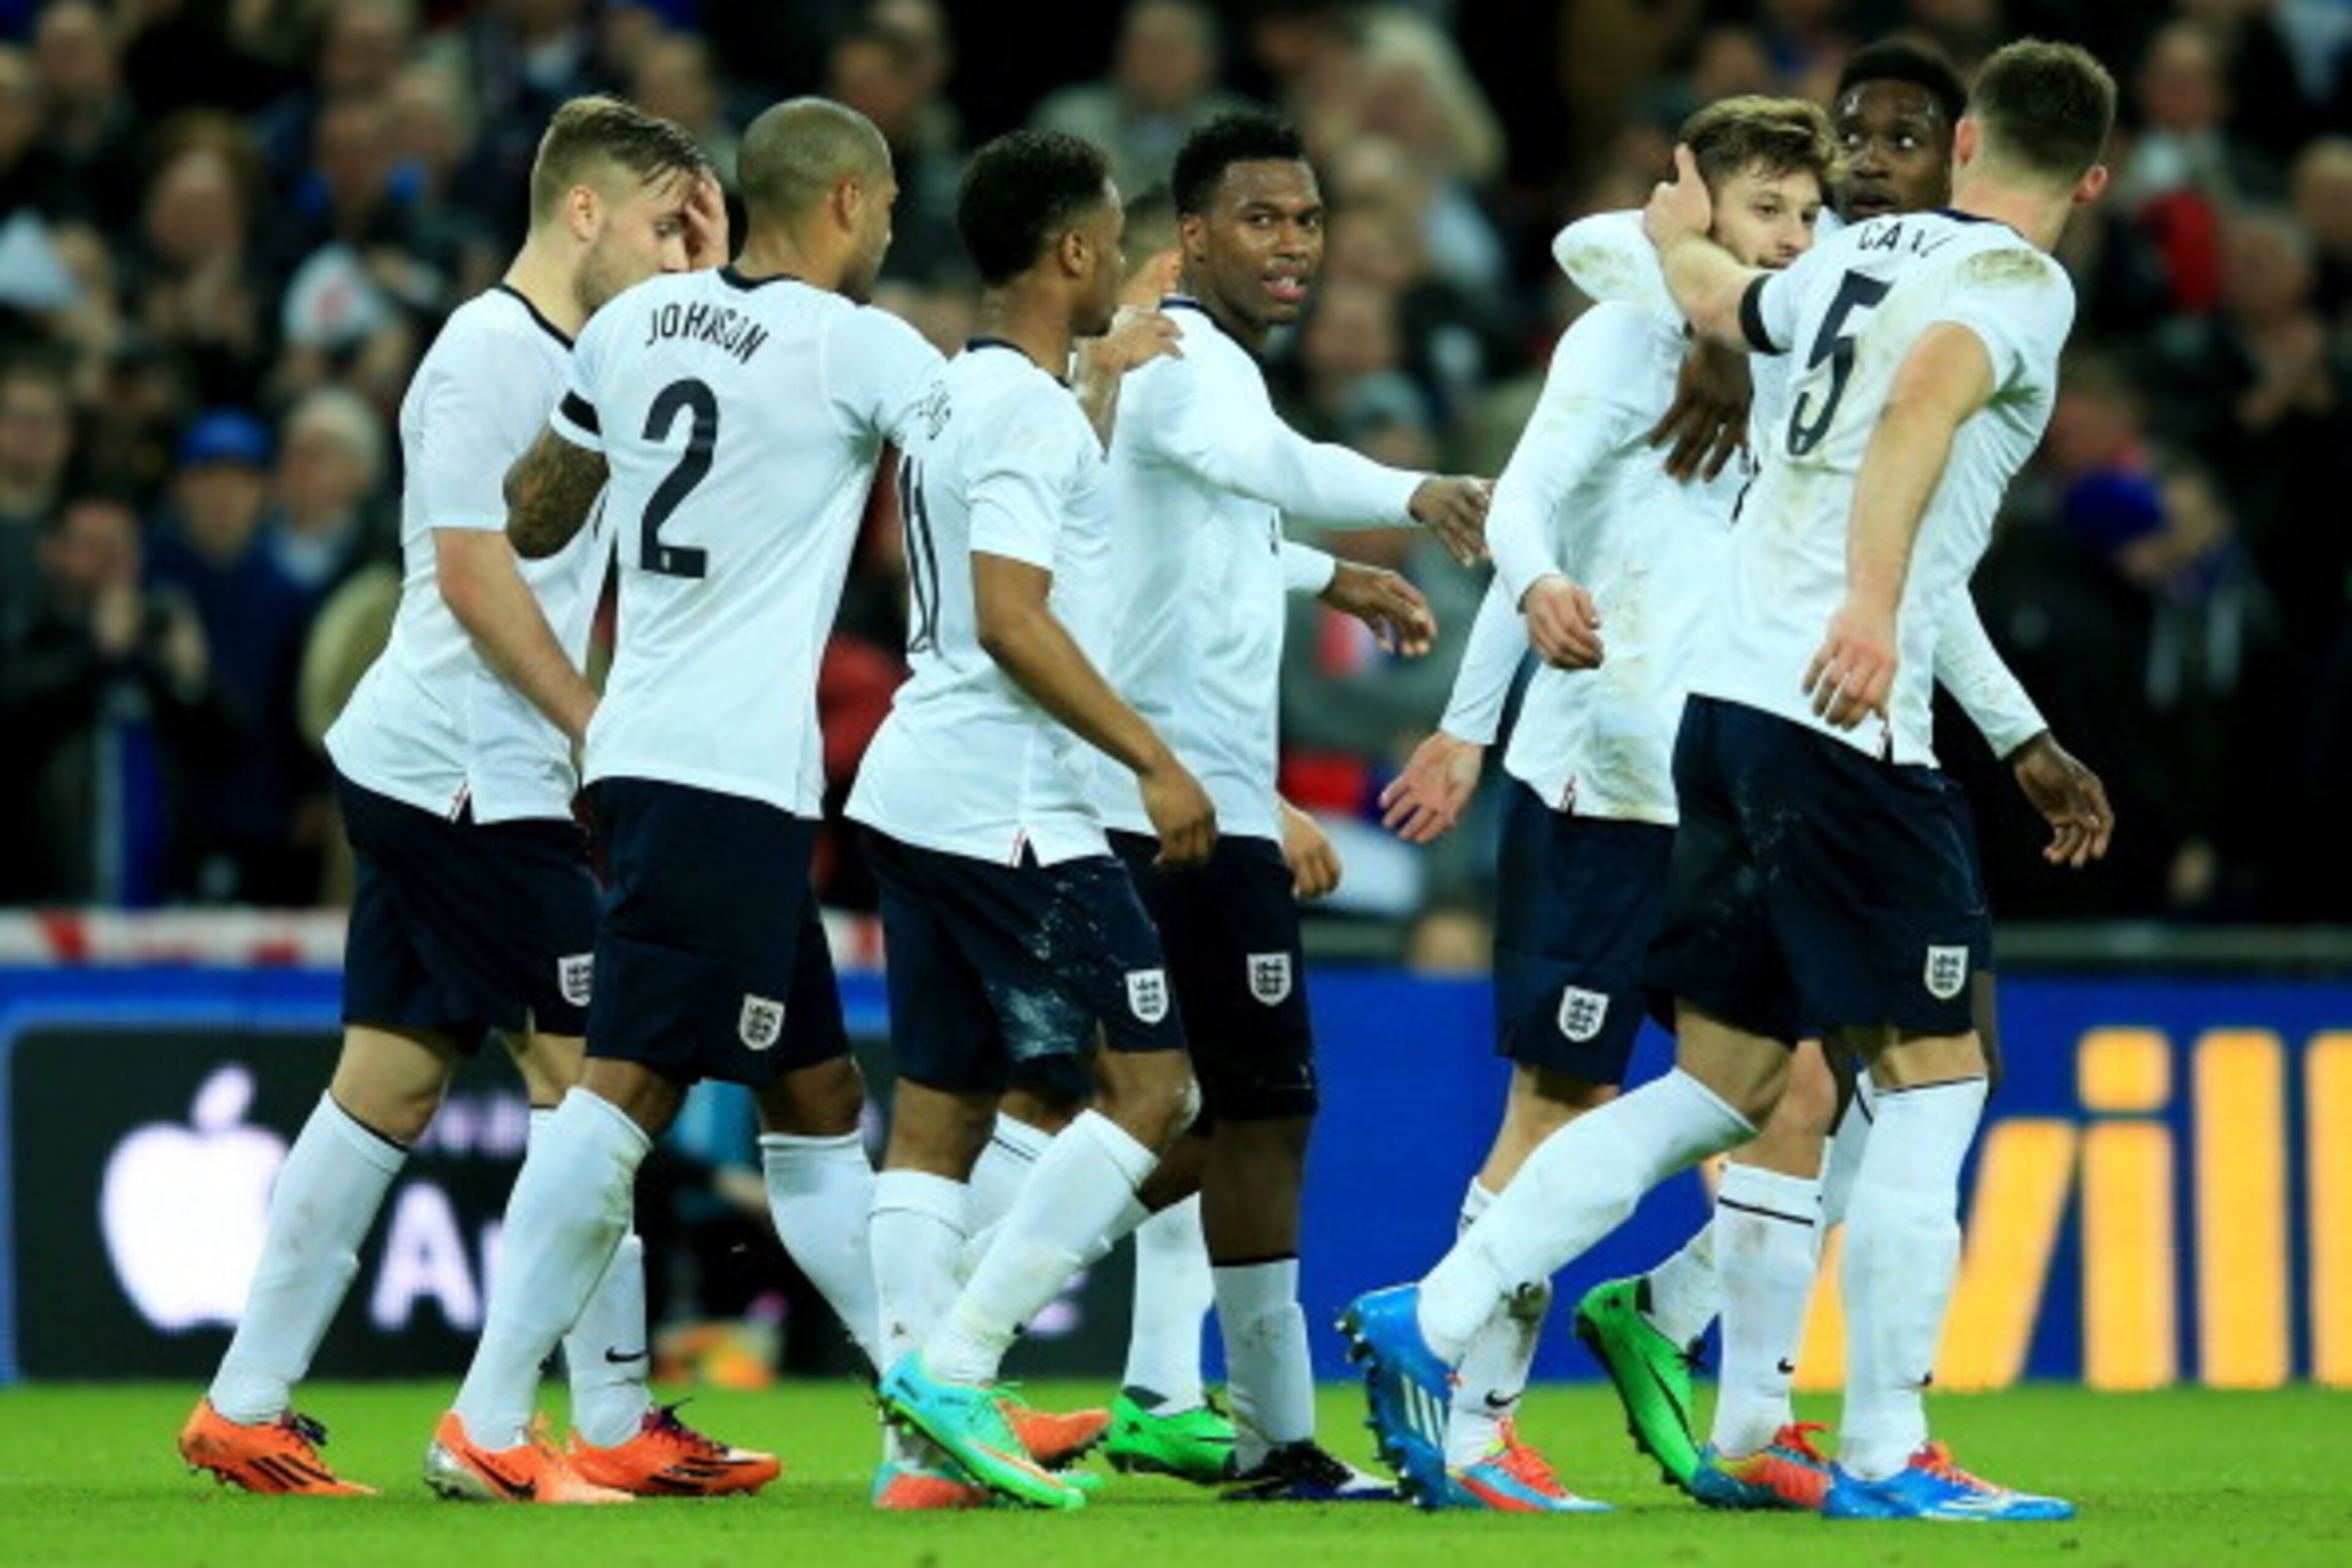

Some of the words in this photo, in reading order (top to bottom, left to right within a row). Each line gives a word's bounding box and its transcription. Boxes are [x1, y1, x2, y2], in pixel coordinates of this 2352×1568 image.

[645, 300, 769, 364] JOHNSON
[1787, 268, 1894, 456] 5
[640, 377, 719, 579] 2
